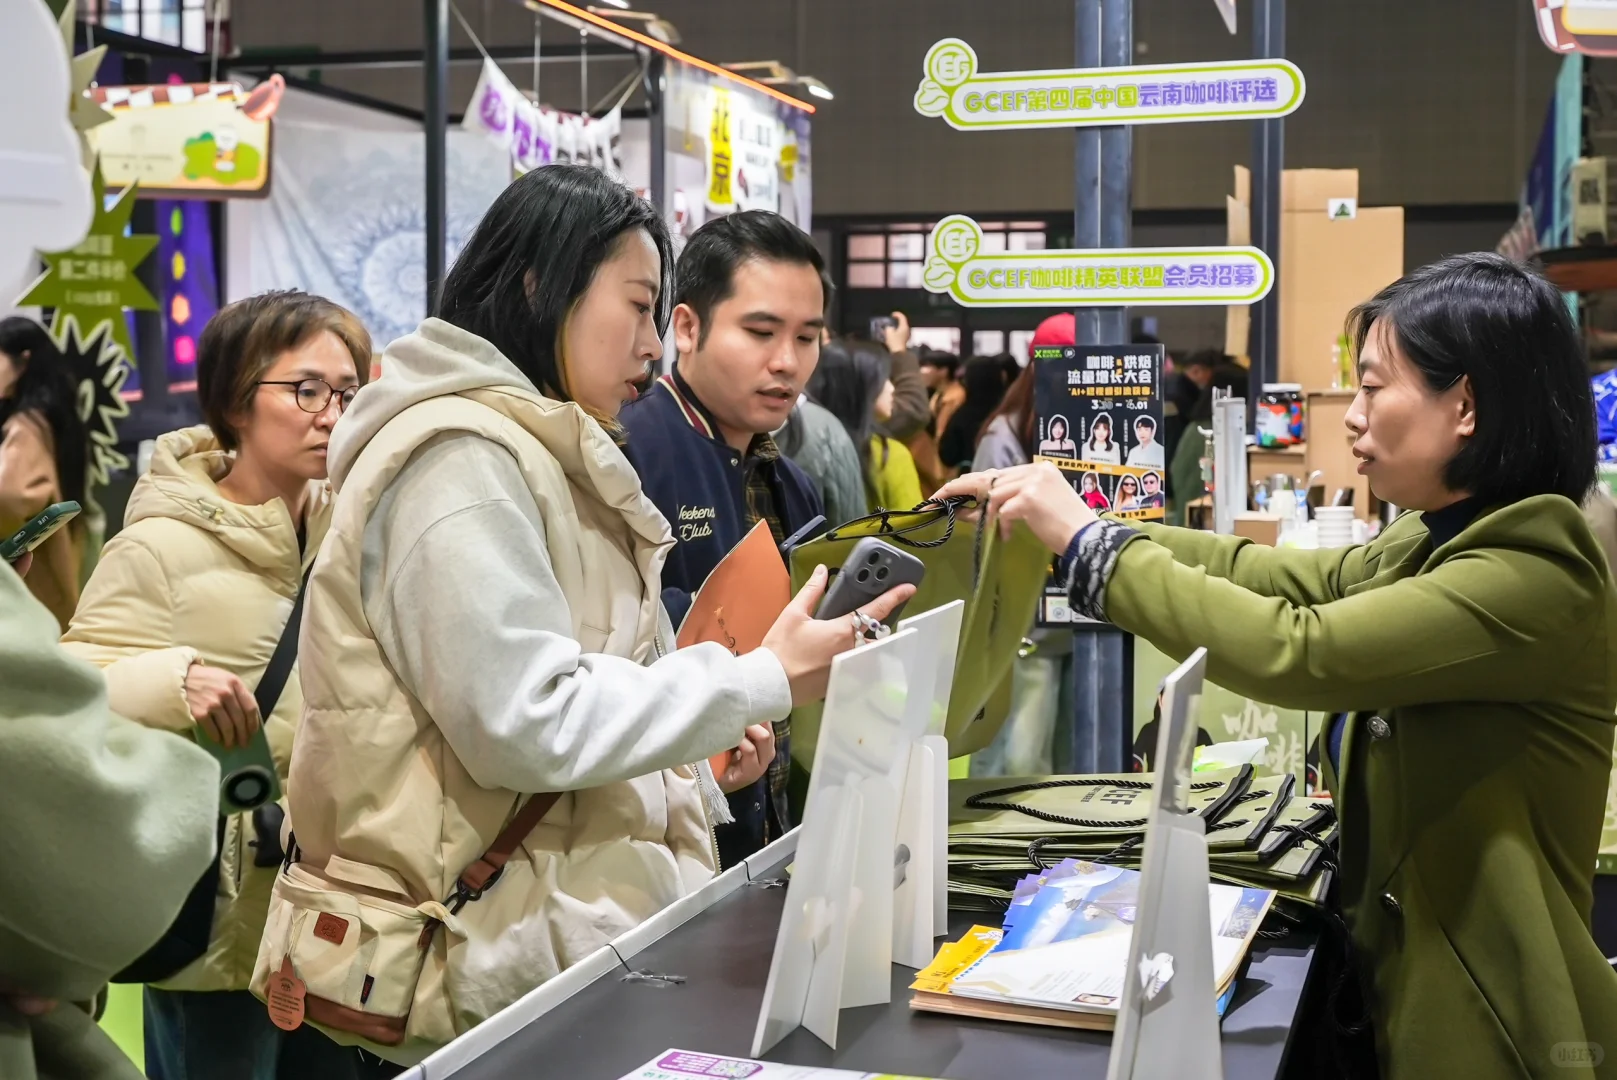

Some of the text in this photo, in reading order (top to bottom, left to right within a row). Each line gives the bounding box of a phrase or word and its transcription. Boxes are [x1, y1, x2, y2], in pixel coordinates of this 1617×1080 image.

[965, 78, 1278, 113] GCEF第四届中国云南咖啡评选
[967, 263, 1258, 290] GCEF咖啡精英联盟会员招募
[1067, 369, 1152, 385] 流量增长大会
[678, 522, 713, 542] Club
